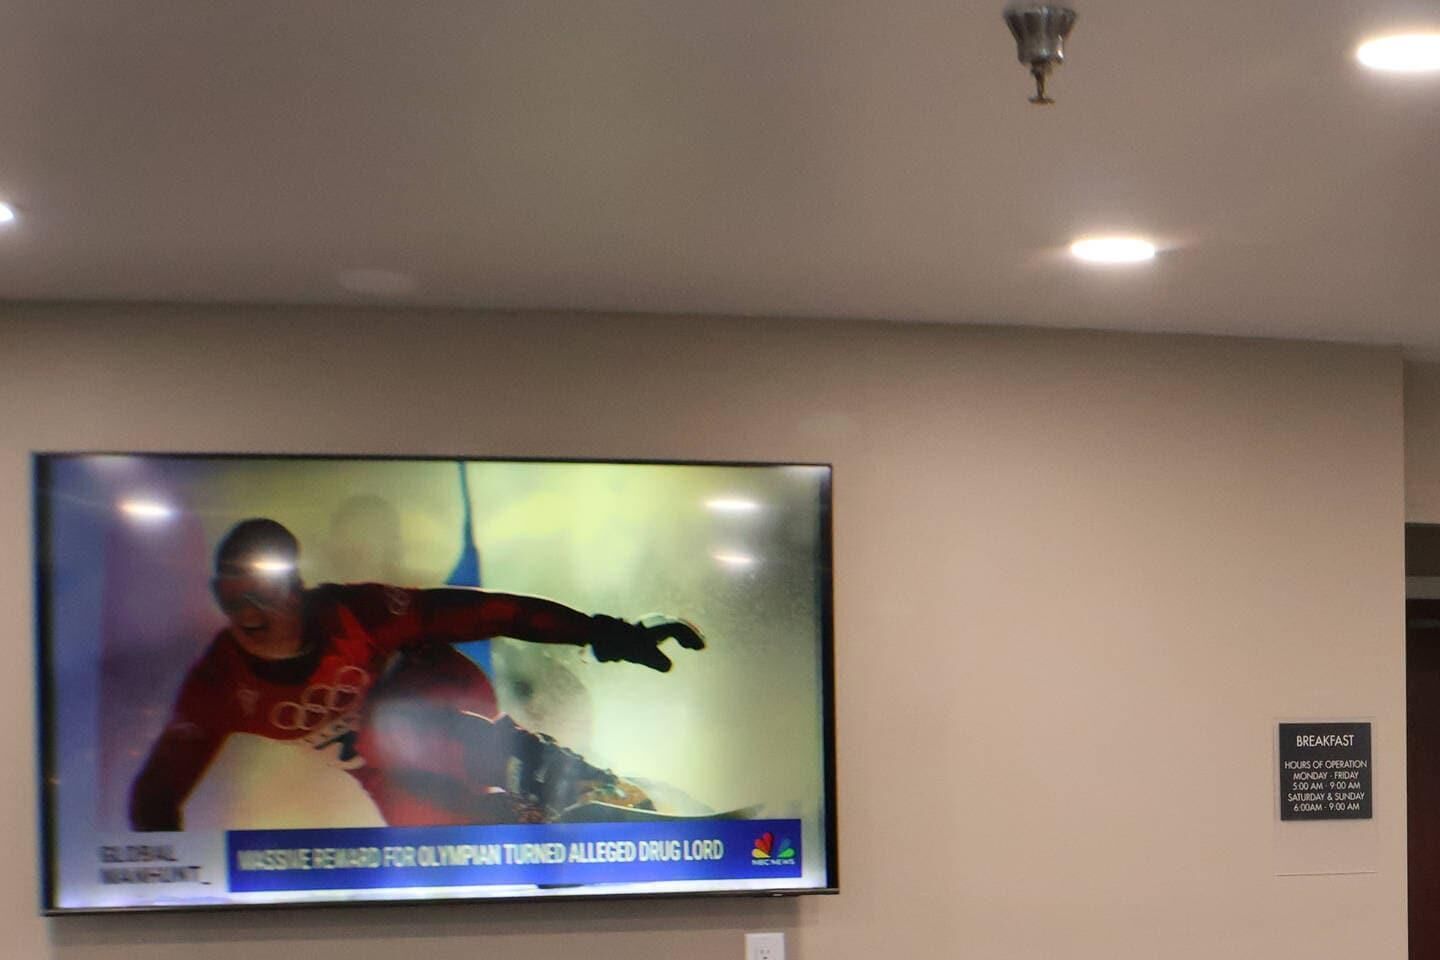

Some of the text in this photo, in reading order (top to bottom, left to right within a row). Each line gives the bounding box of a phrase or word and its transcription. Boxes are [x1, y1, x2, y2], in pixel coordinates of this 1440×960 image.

[1296, 734, 1355, 748] BREAKFAST
[1284, 759, 1367, 769] HOURS OF OPERATION
[1293, 771, 1328, 781] MONDAY
[1334, 770, 1359, 780] FRIDAY
[1310, 782, 1323, 790] AM
[1347, 781, 1361, 790] AM
[1287, 791, 1365, 802] SATURDAY & SUNDAY
[1347, 802, 1360, 811] AM
[237, 838, 724, 871] MASSIVE REWARD FOR OLYMPIAN TURNED ALLEGED DRUG LORD
